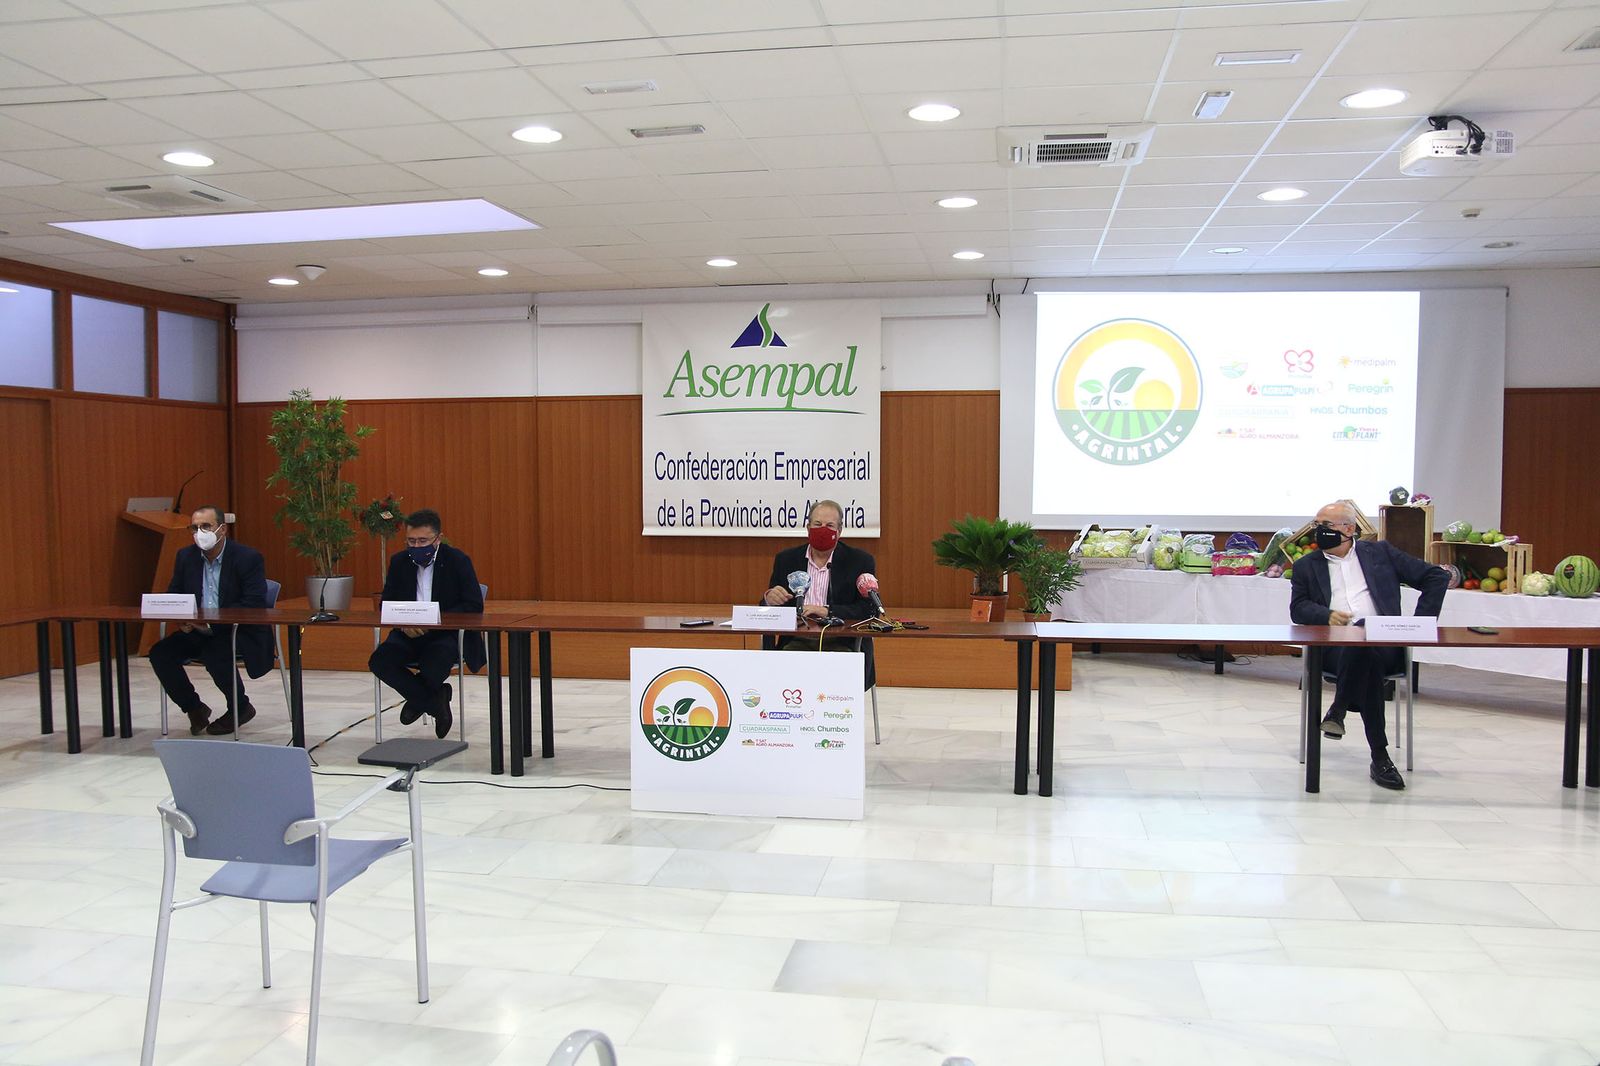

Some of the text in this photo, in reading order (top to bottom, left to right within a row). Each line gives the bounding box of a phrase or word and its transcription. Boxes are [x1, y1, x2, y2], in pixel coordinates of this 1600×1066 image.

[663, 346, 857, 408] Asempal
[1338, 404, 1388, 415] Chumbos
[1074, 429, 1179, 461] AGRINTAL
[654, 451, 871, 488] Confederación Empresarial
[657, 499, 676, 527] de
[681, 499, 694, 527] la
[700, 499, 772, 528] Provincia
[777, 500, 798, 528] de
[817, 725, 850, 733] Chumbos
[654, 738, 718, 759] AGRINTAL
